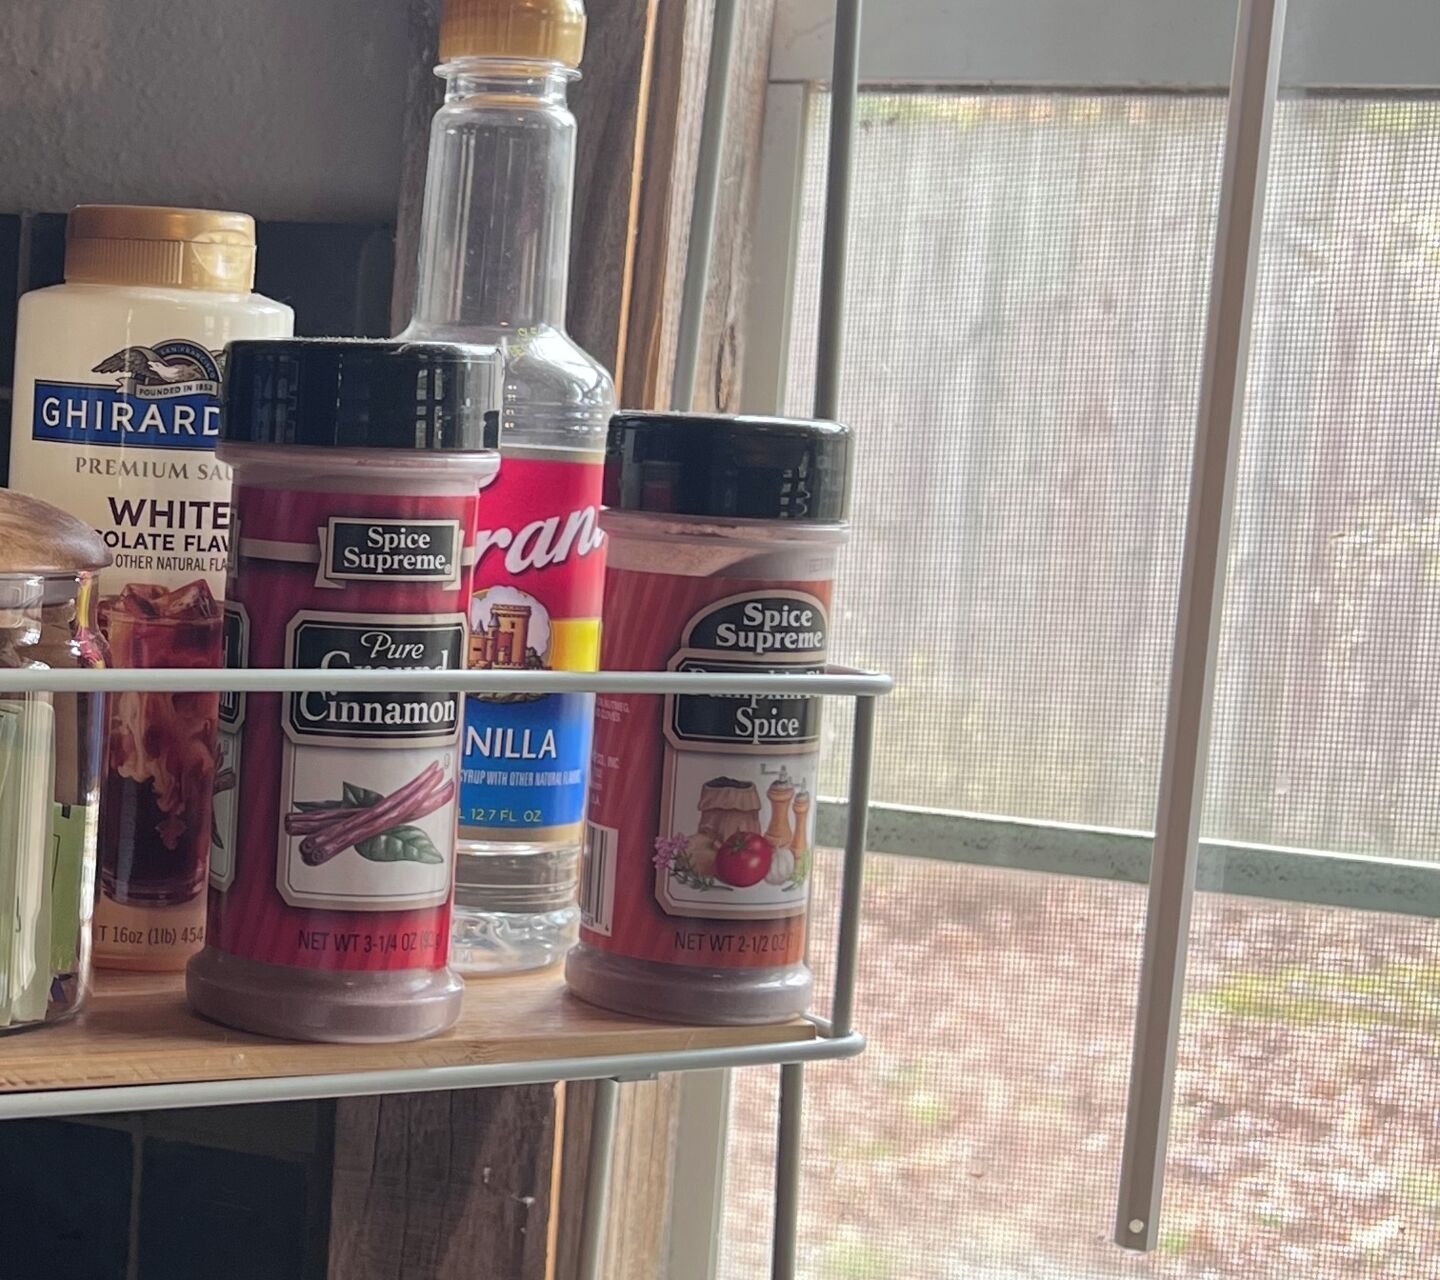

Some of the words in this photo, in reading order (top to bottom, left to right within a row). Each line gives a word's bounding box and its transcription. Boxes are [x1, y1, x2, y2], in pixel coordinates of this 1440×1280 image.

[139, 386, 181, 397] FOUNDED
[183, 384, 193, 393] IN
[76, 456, 190, 480] PREMIUM
[107, 496, 230, 530] WHITE
[100, 529, 175, 551] OLATE
[367, 526, 431, 552] Spice
[116, 553, 153, 570] OTHER
[156, 556, 207, 571] NATURAL
[343, 546, 446, 573] Supreme
[743, 602, 813, 631] Spice
[360, 631, 425, 659] Pure
[716, 623, 823, 655] Supreme
[299, 690, 455, 725] Cinnamon
[734, 706, 800, 745] Spice
[465, 725, 557, 759] NILLA
[500, 809, 516, 822] FL
[523, 810, 542, 822] OZ
[113, 926, 143, 944] 16oz
[298, 929, 329, 951] NET
[334, 933, 359, 952] WT
[401, 932, 417, 951] OZ
[674, 931, 705, 951] NET
[710, 933, 735, 952] WT
